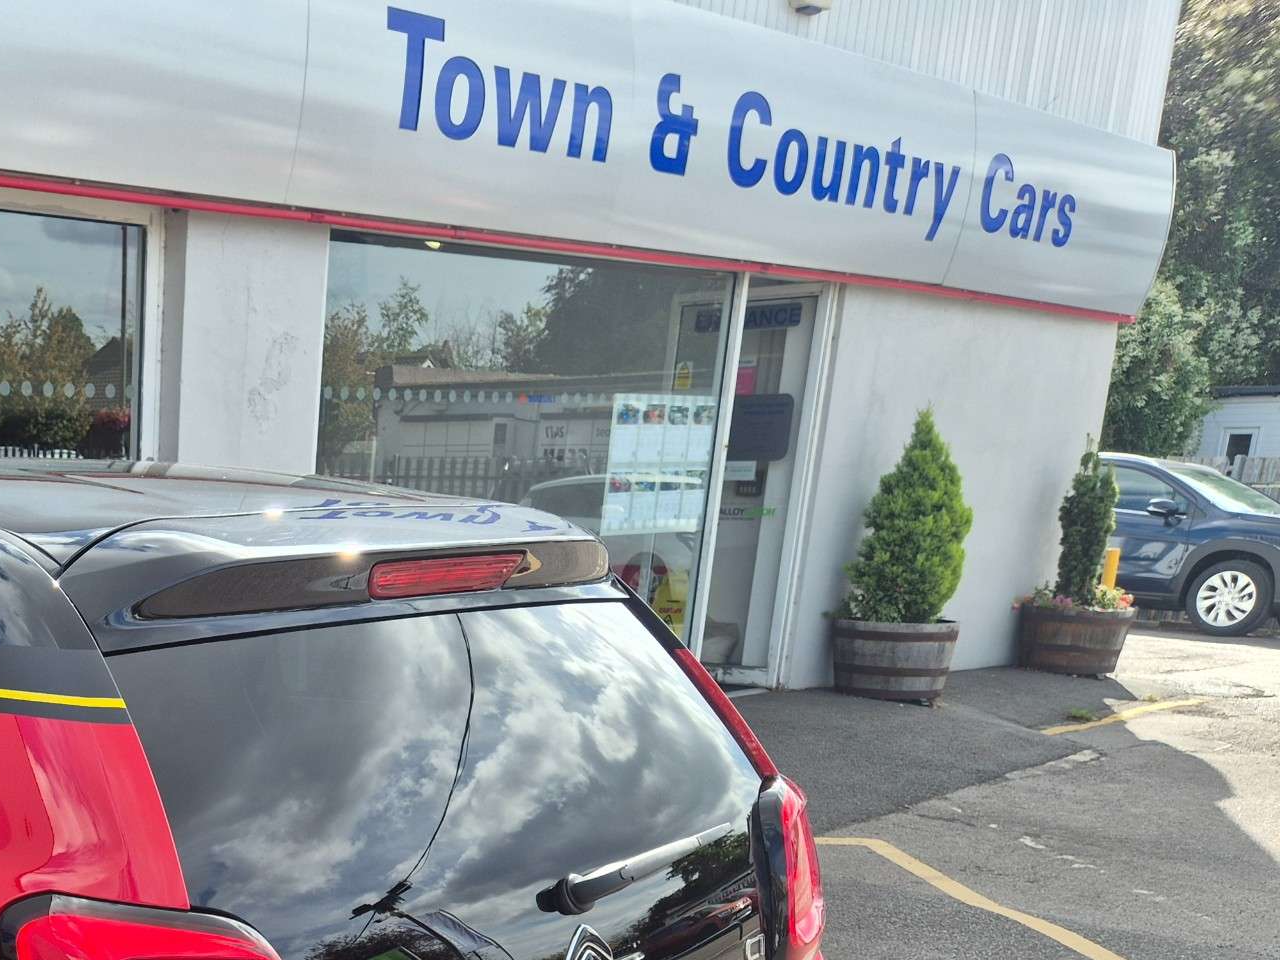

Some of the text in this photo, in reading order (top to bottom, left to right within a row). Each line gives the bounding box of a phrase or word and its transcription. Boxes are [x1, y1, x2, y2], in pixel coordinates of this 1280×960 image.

[386, 5, 1076, 248] Town & Country Cars
